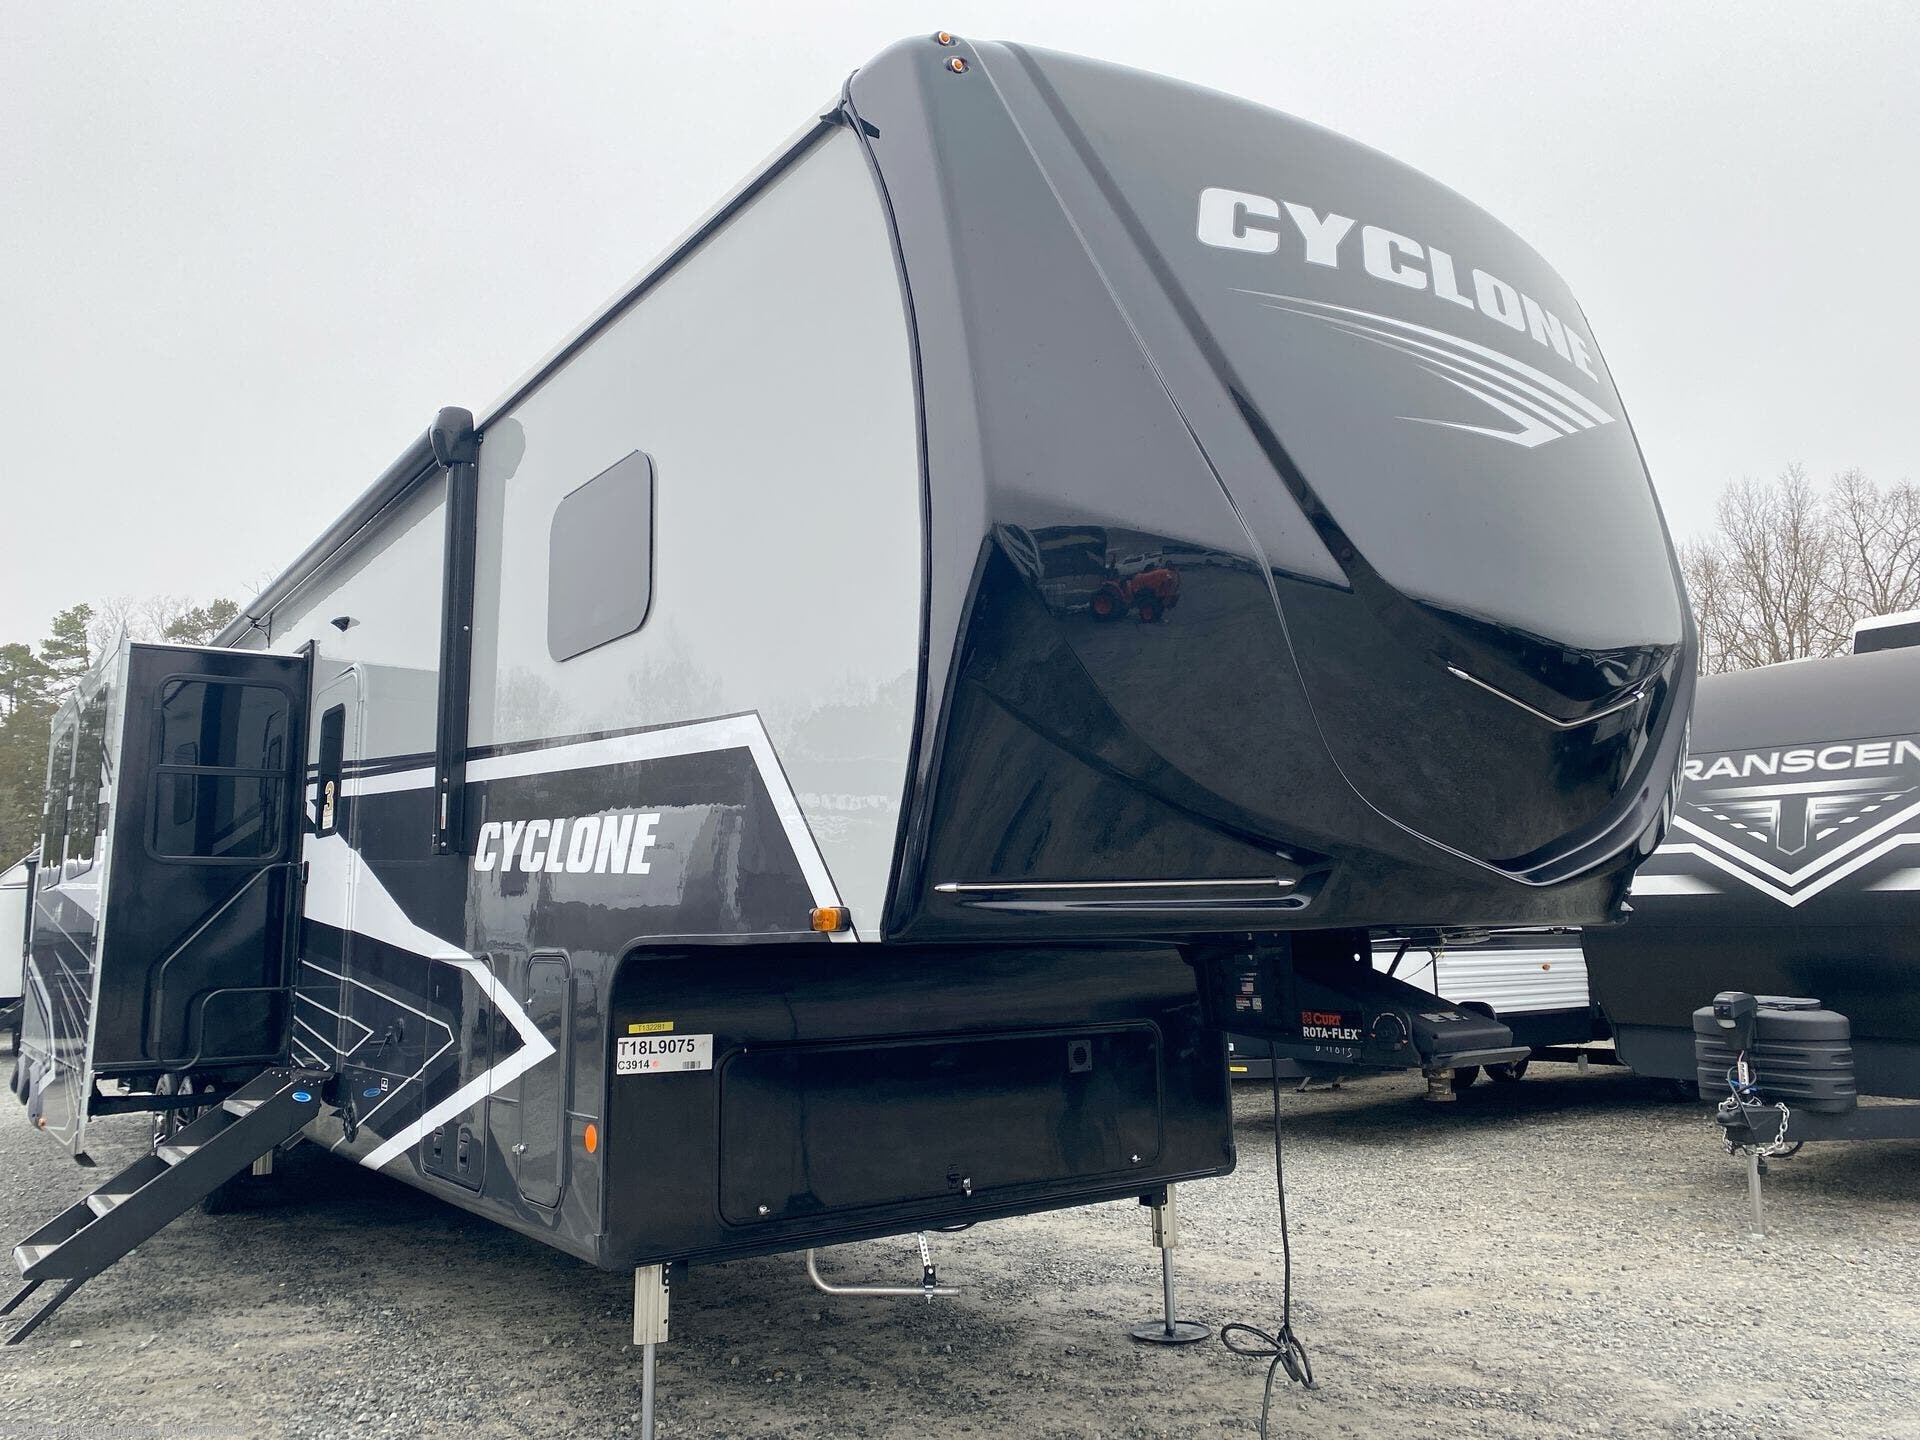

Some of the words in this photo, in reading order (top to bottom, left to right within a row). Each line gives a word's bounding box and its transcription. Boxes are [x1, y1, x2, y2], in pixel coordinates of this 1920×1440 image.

[1197, 187, 1599, 382] CYCLONE
[474, 813, 661, 875] CYCLONE
[1313, 1013, 1341, 1025] CURT
[638, 1023, 665, 1032] T132281
[619, 1039, 695, 1056] T18L9075
[618, 1059, 650, 1070] C3914
